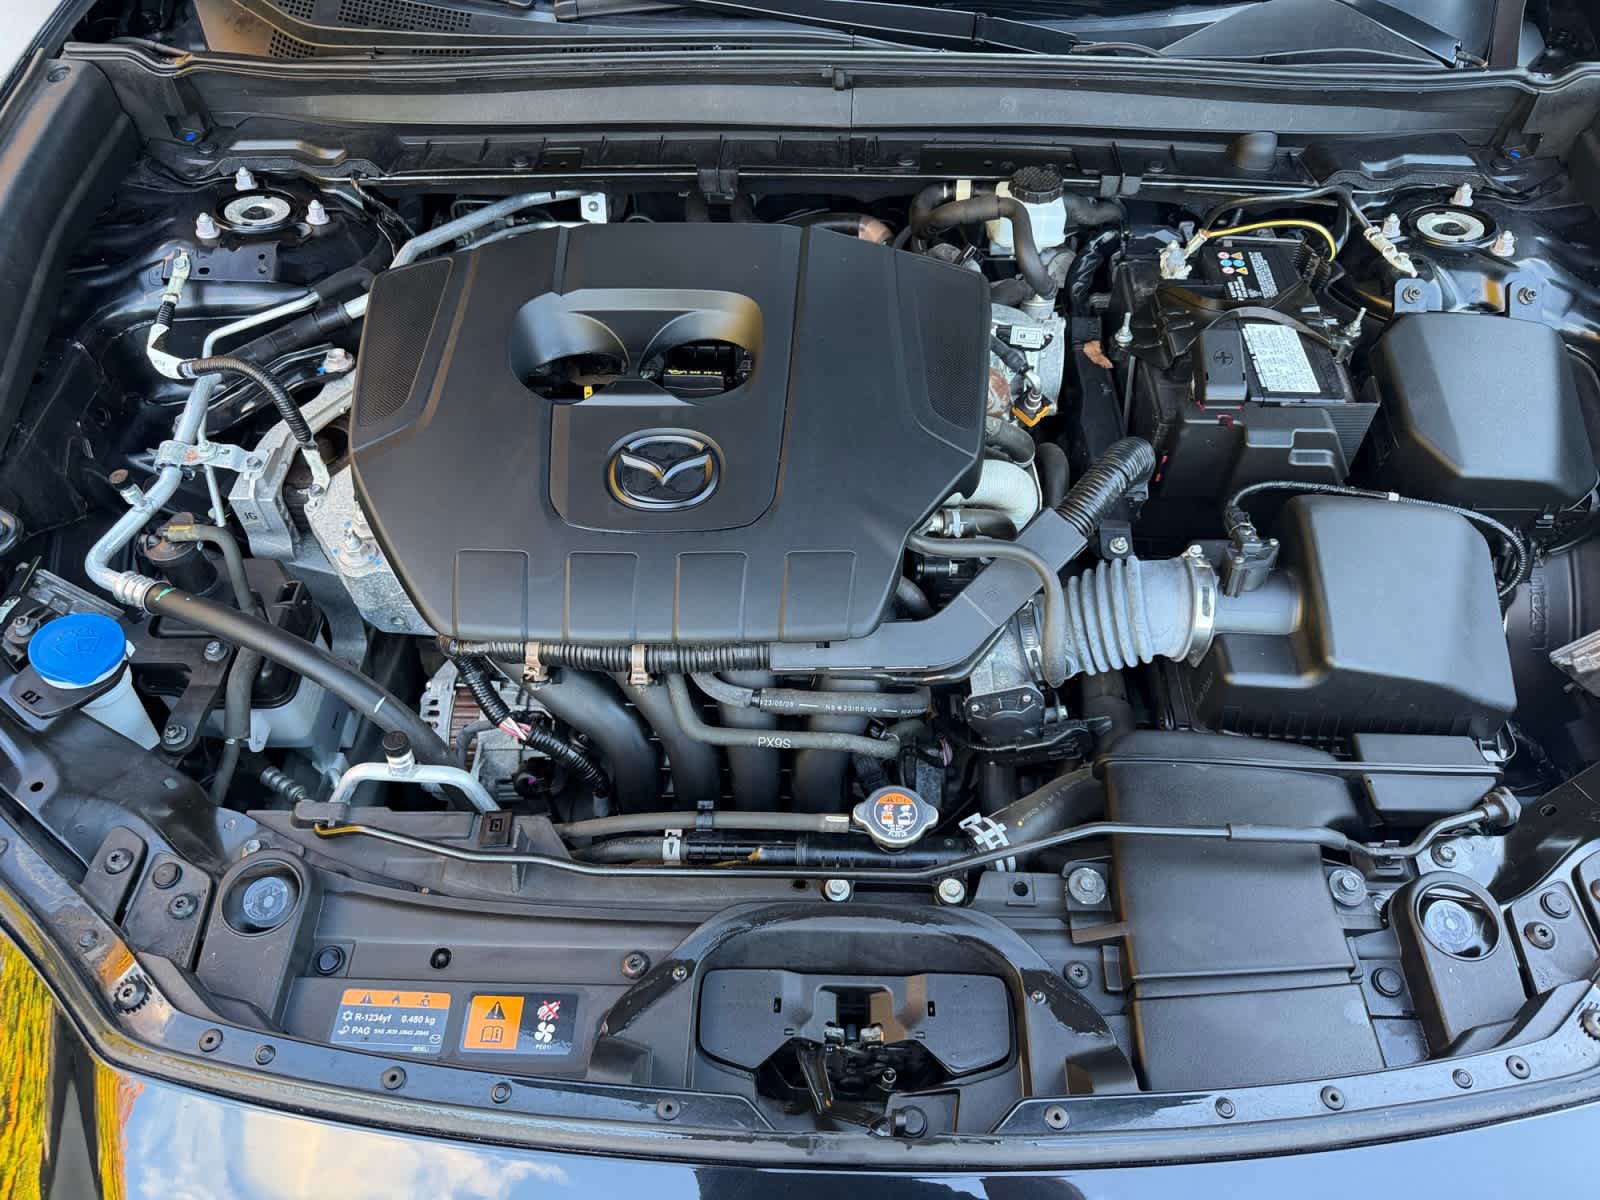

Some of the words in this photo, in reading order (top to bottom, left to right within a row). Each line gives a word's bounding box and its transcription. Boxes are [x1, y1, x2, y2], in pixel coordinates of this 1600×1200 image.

[757, 736, 792, 749] PX9S
[354, 1012, 393, 1024] R-1234yf
[351, 1026, 371, 1035] PAG
